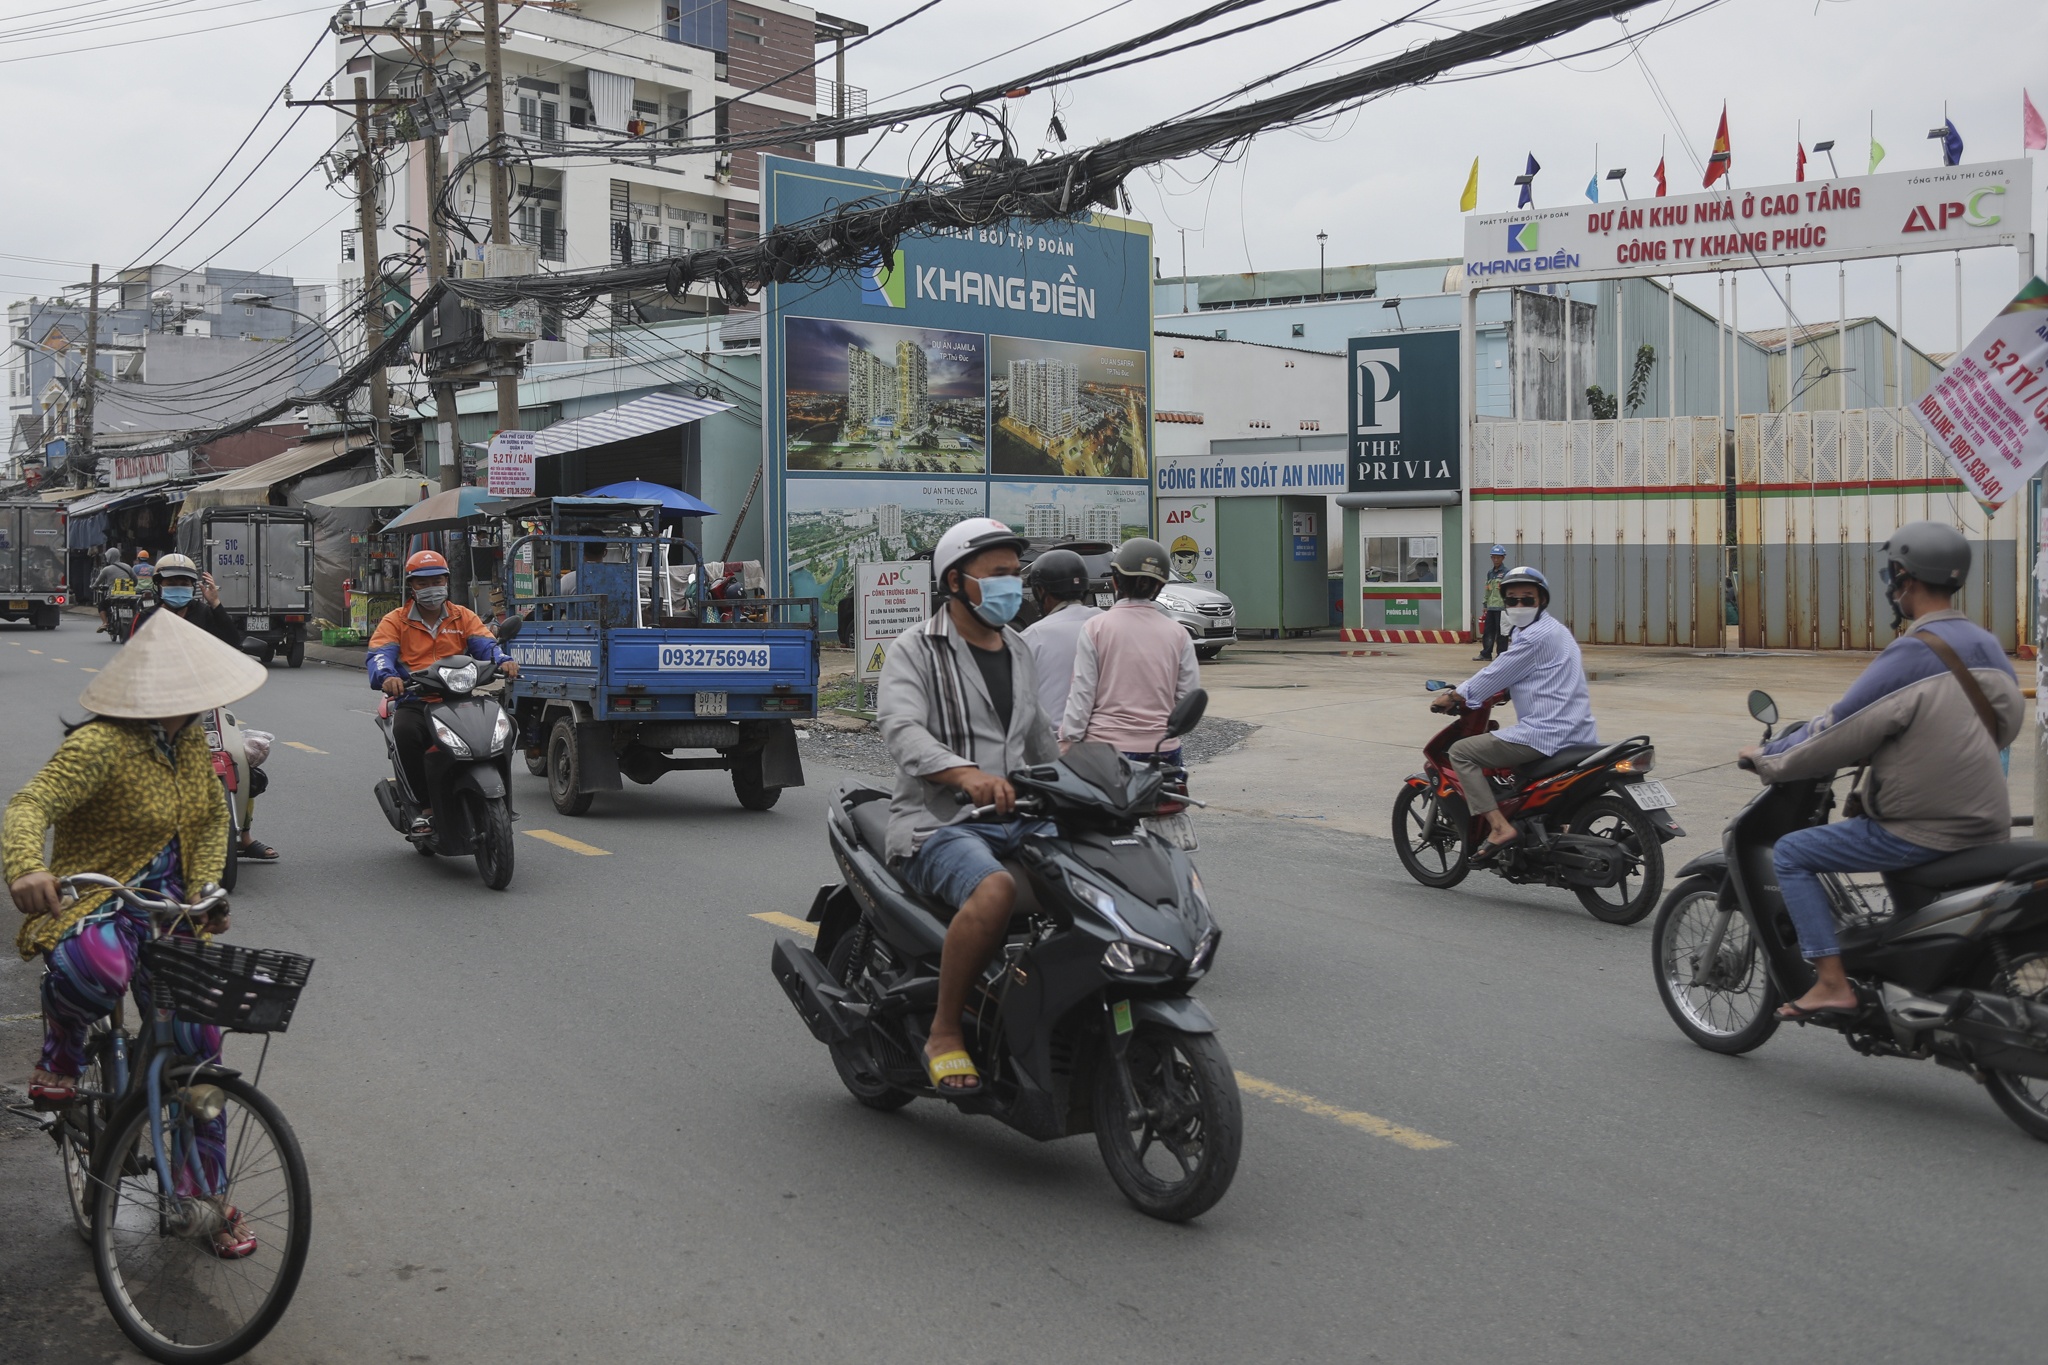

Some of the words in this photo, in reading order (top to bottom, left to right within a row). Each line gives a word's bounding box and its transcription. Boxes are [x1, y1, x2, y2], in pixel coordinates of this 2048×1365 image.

[1908, 176, 1930, 185] TỔNG
[1934, 173, 1957, 182] THẦU
[1979, 169, 2004, 177] CÔNG
[1588, 210, 1614, 236] DỰ
[1617, 206, 1643, 230] ÁN
[1650, 205, 1688, 227] KHU
[1694, 196, 1734, 223] NHÀ
[1742, 191, 1754, 219] Ở
[1760, 193, 1799, 217] CAO
[1806, 183, 1861, 212] TẦNG
[1901, 185, 2006, 233] APC
[1008, 231, 1033, 252] TẬP
[1039, 237, 1074, 256] ĐOÀN
[1617, 239, 1666, 263] CÔNG
[1673, 238, 1695, 259] TY
[1701, 231, 1767, 257] KHANG
[1772, 223, 1826, 250] PHÚC
[1467, 258, 1531, 276] KHANG
[1534, 247, 1579, 271] ĐIỀN
[953, 343, 976, 351] JAMILA
[1979, 337, 2020, 378] 5,2
[2002, 355, 2047, 398] TỶ
[2022, 386, 2048, 404] /
[1357, 440, 1400, 457] THE
[1917, 393, 1957, 442] HOTLINE:
[1947, 434, 2004, 501] 0907.936.491
[1997, 443, 2015, 462] TRAO
[2009, 456, 2023, 470] TAY
[494, 454, 503, 464] 5,2
[1158, 460, 1196, 490] CỔNG
[1200, 458, 1236, 489] KIỂM
[1241, 461, 1278, 488] SOÁT
[1282, 465, 1302, 487] AN
[1307, 464, 1345, 486] NINH
[1357, 460, 1451, 481] PRIVIA
[944, 487, 955, 495] THE
[957, 487, 978, 495] VENICA
[1166, 504, 1206, 523] APC
[225, 539, 238, 550] 51C
[219, 554, 244, 565] 554.46
[877, 565, 912, 586] APC
[536, 644, 551, 665] HÀNG
[554, 649, 592, 666] 0932756948
[662, 648, 767, 667] 0932756948
